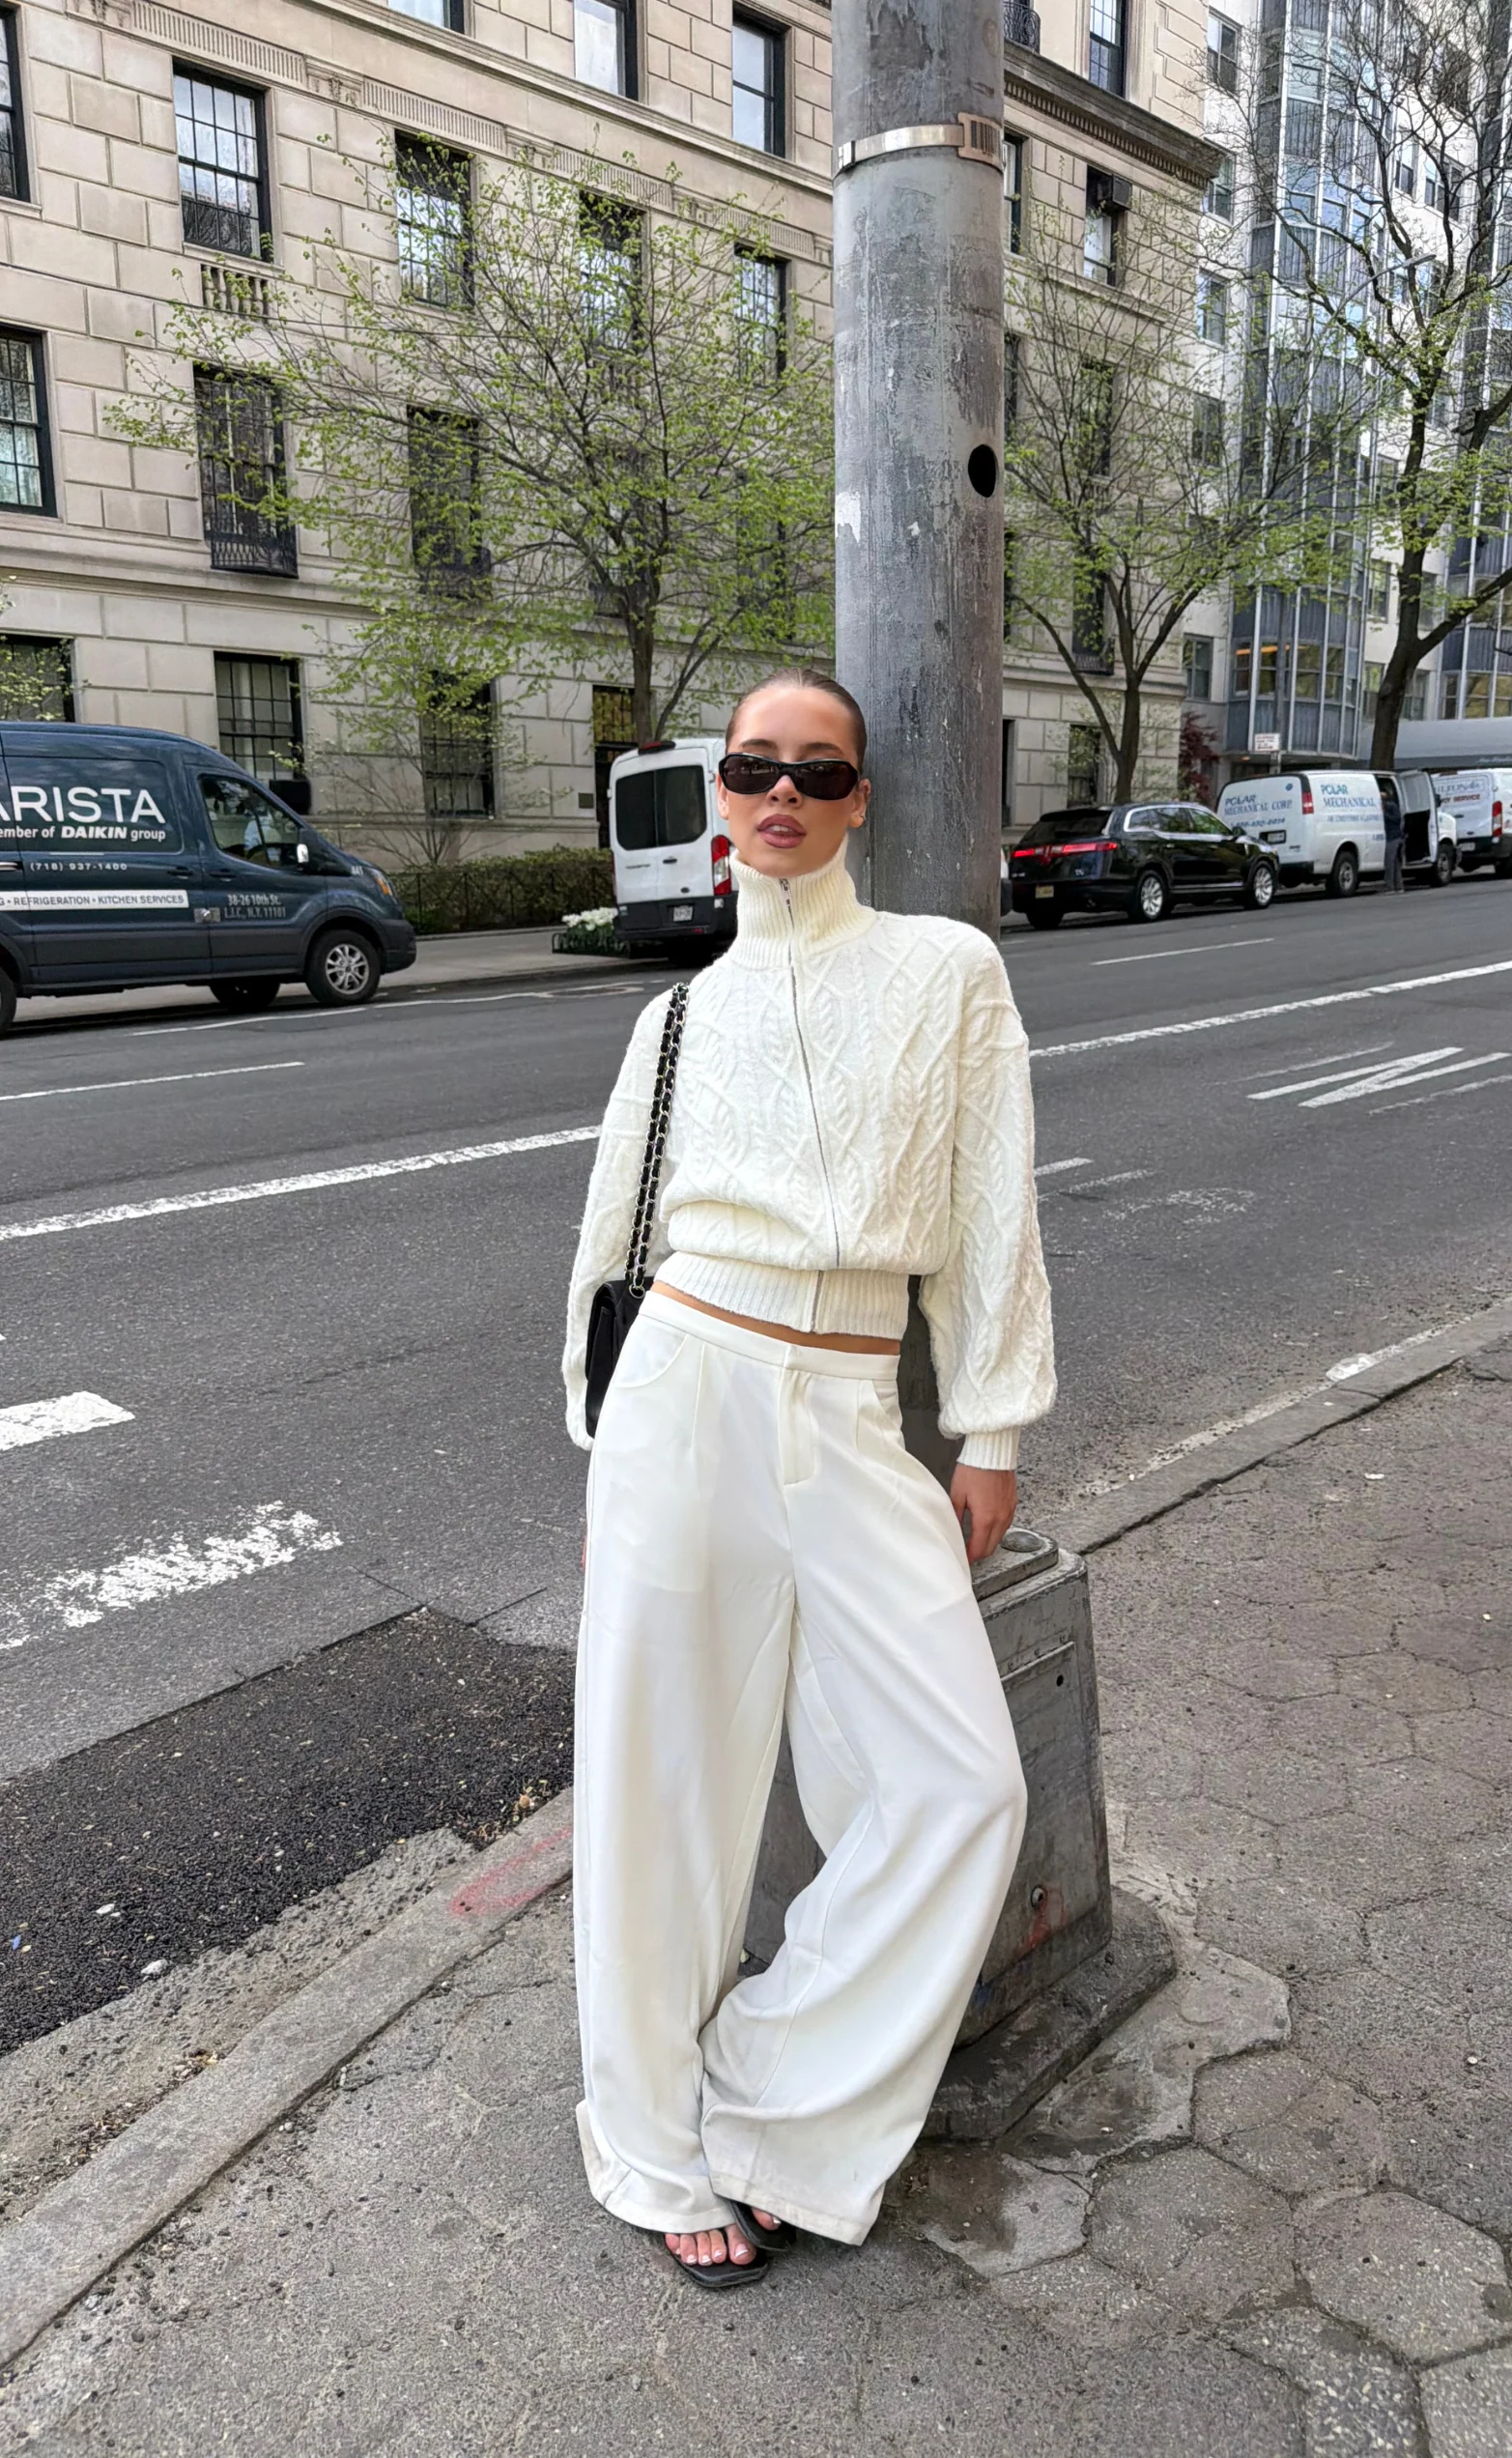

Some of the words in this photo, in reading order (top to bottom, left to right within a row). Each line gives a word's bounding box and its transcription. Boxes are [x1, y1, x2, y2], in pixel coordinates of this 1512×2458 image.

[1320, 784, 1349, 795] POLAR
[0, 786, 166, 824] RISTA
[1225, 794, 1257, 806] POLAR
[1323, 796, 1377, 809] MECHANICAL
[42, 825, 56, 839] of
[61, 826, 128, 839] DAIKIN
[130, 830, 166, 843] group
[30, 862, 64, 872] (718)
[69, 862, 128, 871] 937-1400
[13, 896, 91, 906] REFRIGERATION
[98, 895, 138, 904] KITCHEN
[139, 895, 185, 904] SERVICES
